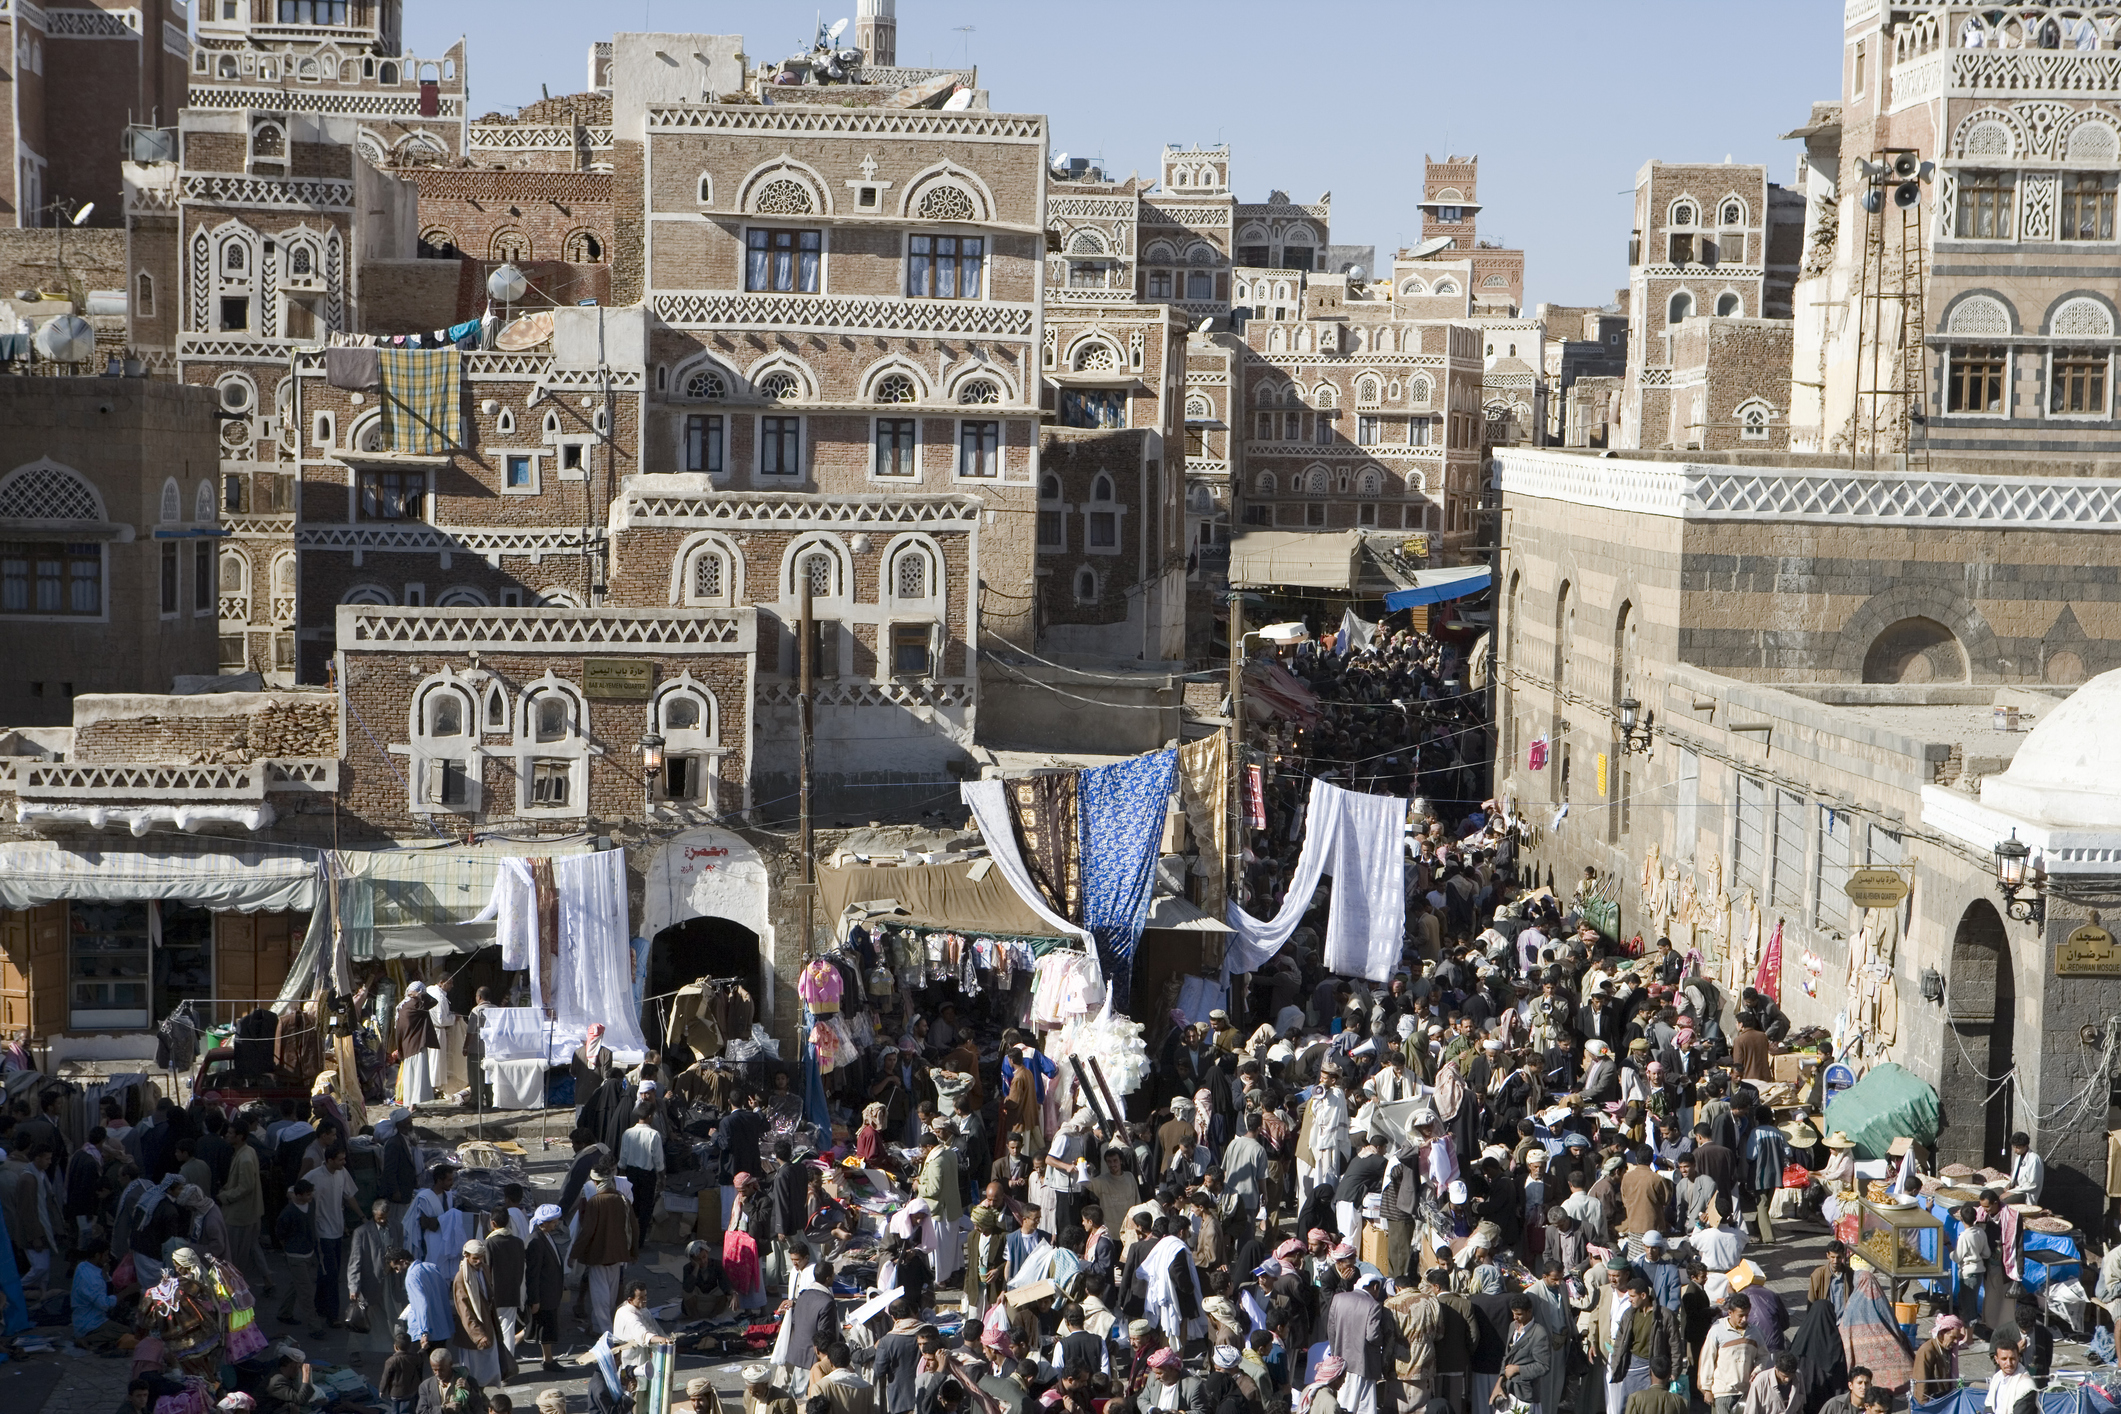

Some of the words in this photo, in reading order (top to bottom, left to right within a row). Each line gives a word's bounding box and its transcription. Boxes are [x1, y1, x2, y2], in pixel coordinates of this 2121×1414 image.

[590, 666, 612, 676] اليمن
[615, 667, 627, 677] باب
[630, 666, 645, 676] حارة
[623, 682, 646, 690] QUARTER
[1858, 876, 1874, 884] اليمن
[1875, 877, 1885, 885] باب
[1886, 876, 1897, 885] حارة
[1863, 892, 1880, 900] AL-YEMEN
[2075, 932, 2106, 944] مسجد
[2066, 950, 2114, 961] الرضوان
[2059, 963, 2096, 971] AL-REDHWAN
[2096, 964, 2120, 972] MOSQUE
